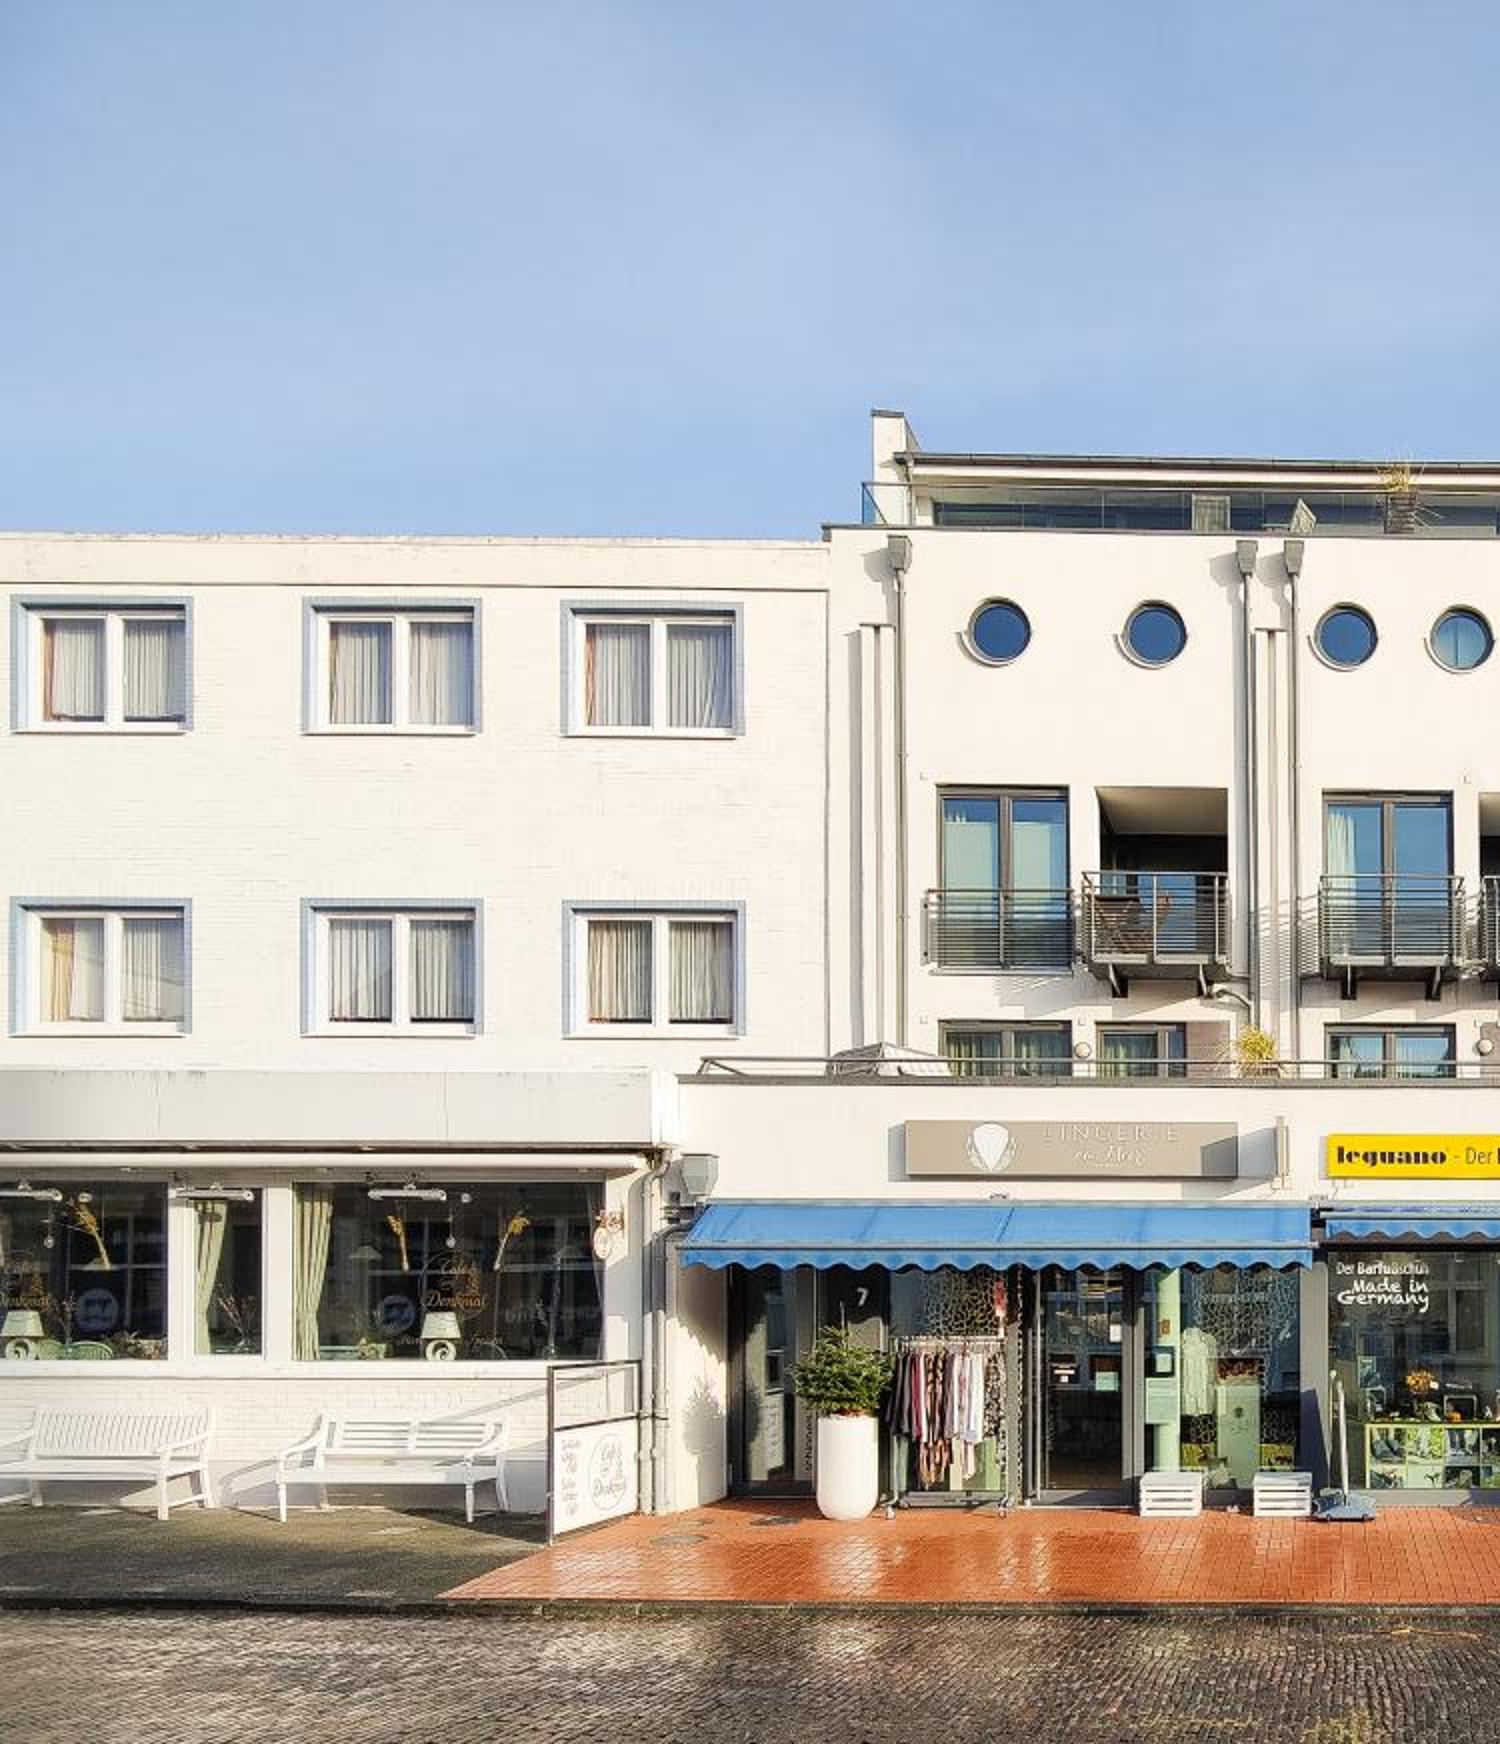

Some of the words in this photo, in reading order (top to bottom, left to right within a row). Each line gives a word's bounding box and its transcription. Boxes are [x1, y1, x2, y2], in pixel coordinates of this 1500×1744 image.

[1044, 1124, 1177, 1141] LINGERE
[1465, 1147, 1492, 1165] Der
[1336, 1261, 1355, 1275] Der
[1352, 1276, 1402, 1293] Made
[1409, 1279, 1429, 1293] in
[857, 1287, 868, 1307] 7
[1337, 1290, 1430, 1313] Germany
